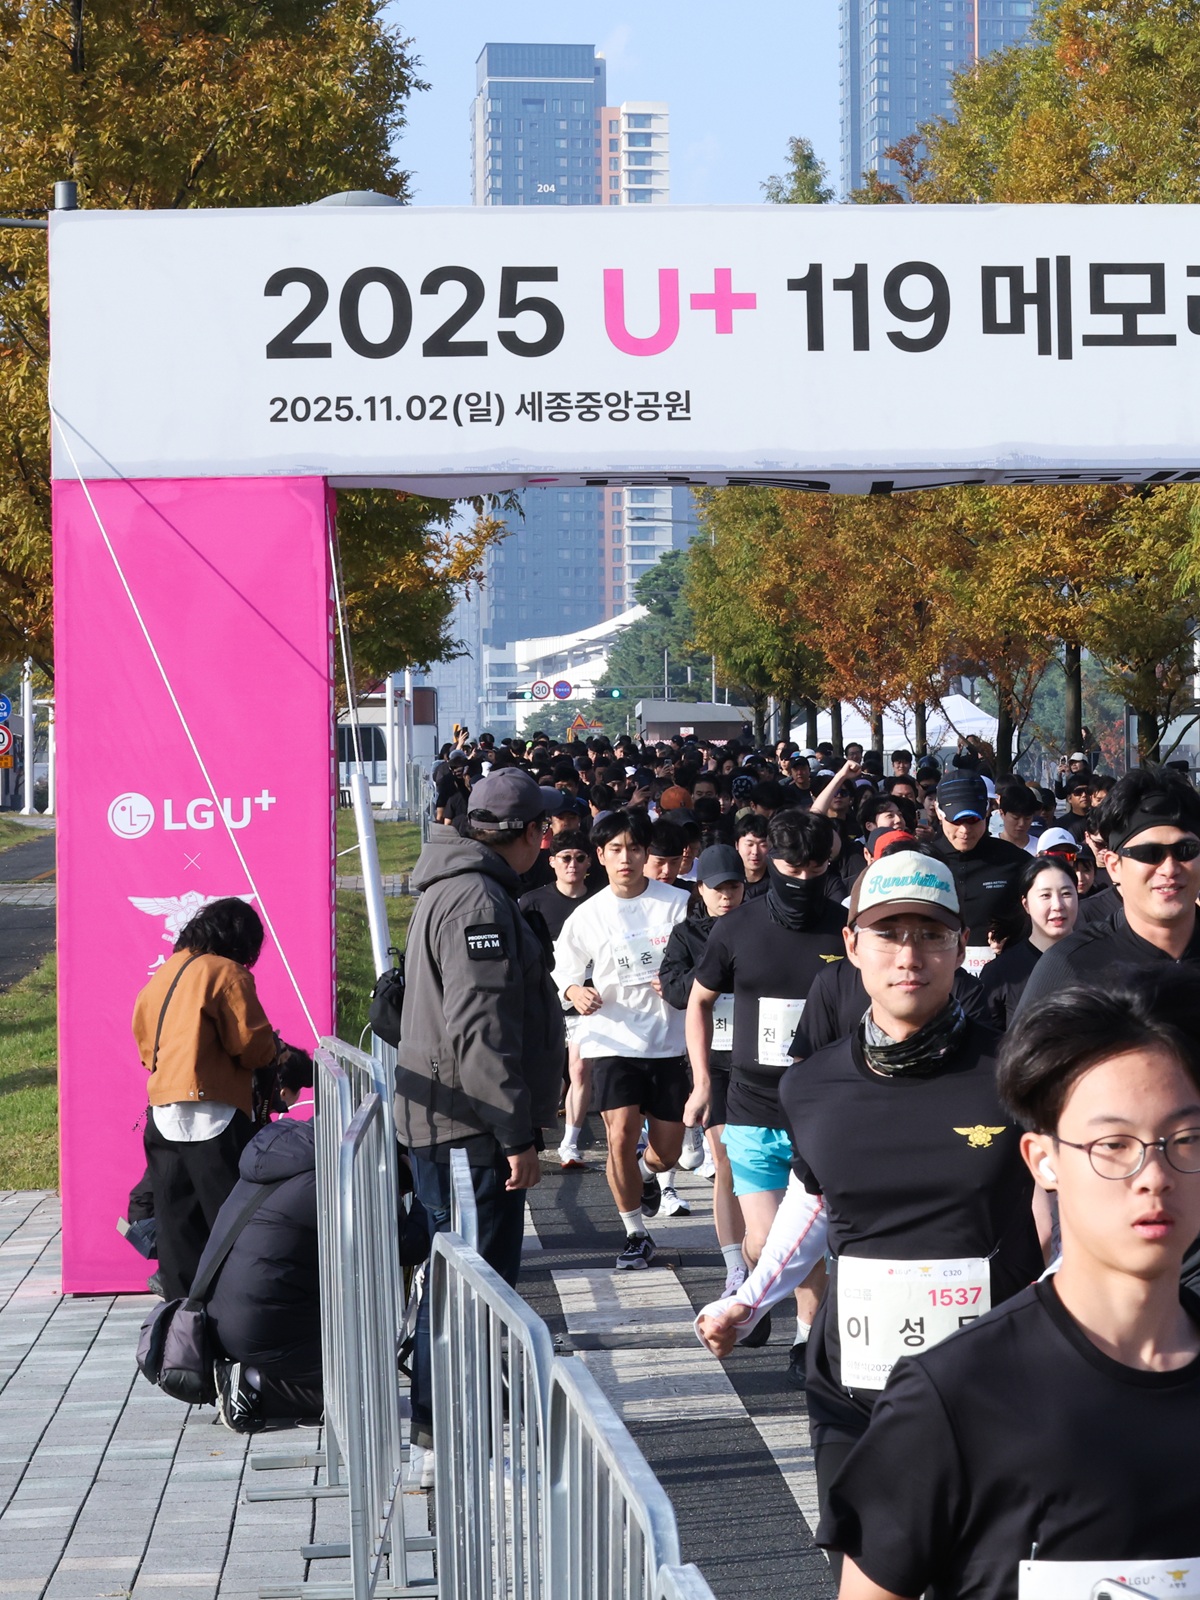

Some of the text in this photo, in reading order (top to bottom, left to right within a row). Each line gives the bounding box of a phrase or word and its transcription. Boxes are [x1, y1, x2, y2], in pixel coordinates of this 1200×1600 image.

[536, 183, 556, 193] 204
[264, 266, 565, 359] 2025
[604, 268, 757, 357] U+
[787, 262, 951, 352] 119
[269, 390, 691, 427] 2025.11.02(일) 세종중앙공원
[535, 685, 547, 695] 30
[469, 940, 500, 949] TEAM
[928, 1287, 982, 1306] 1537
